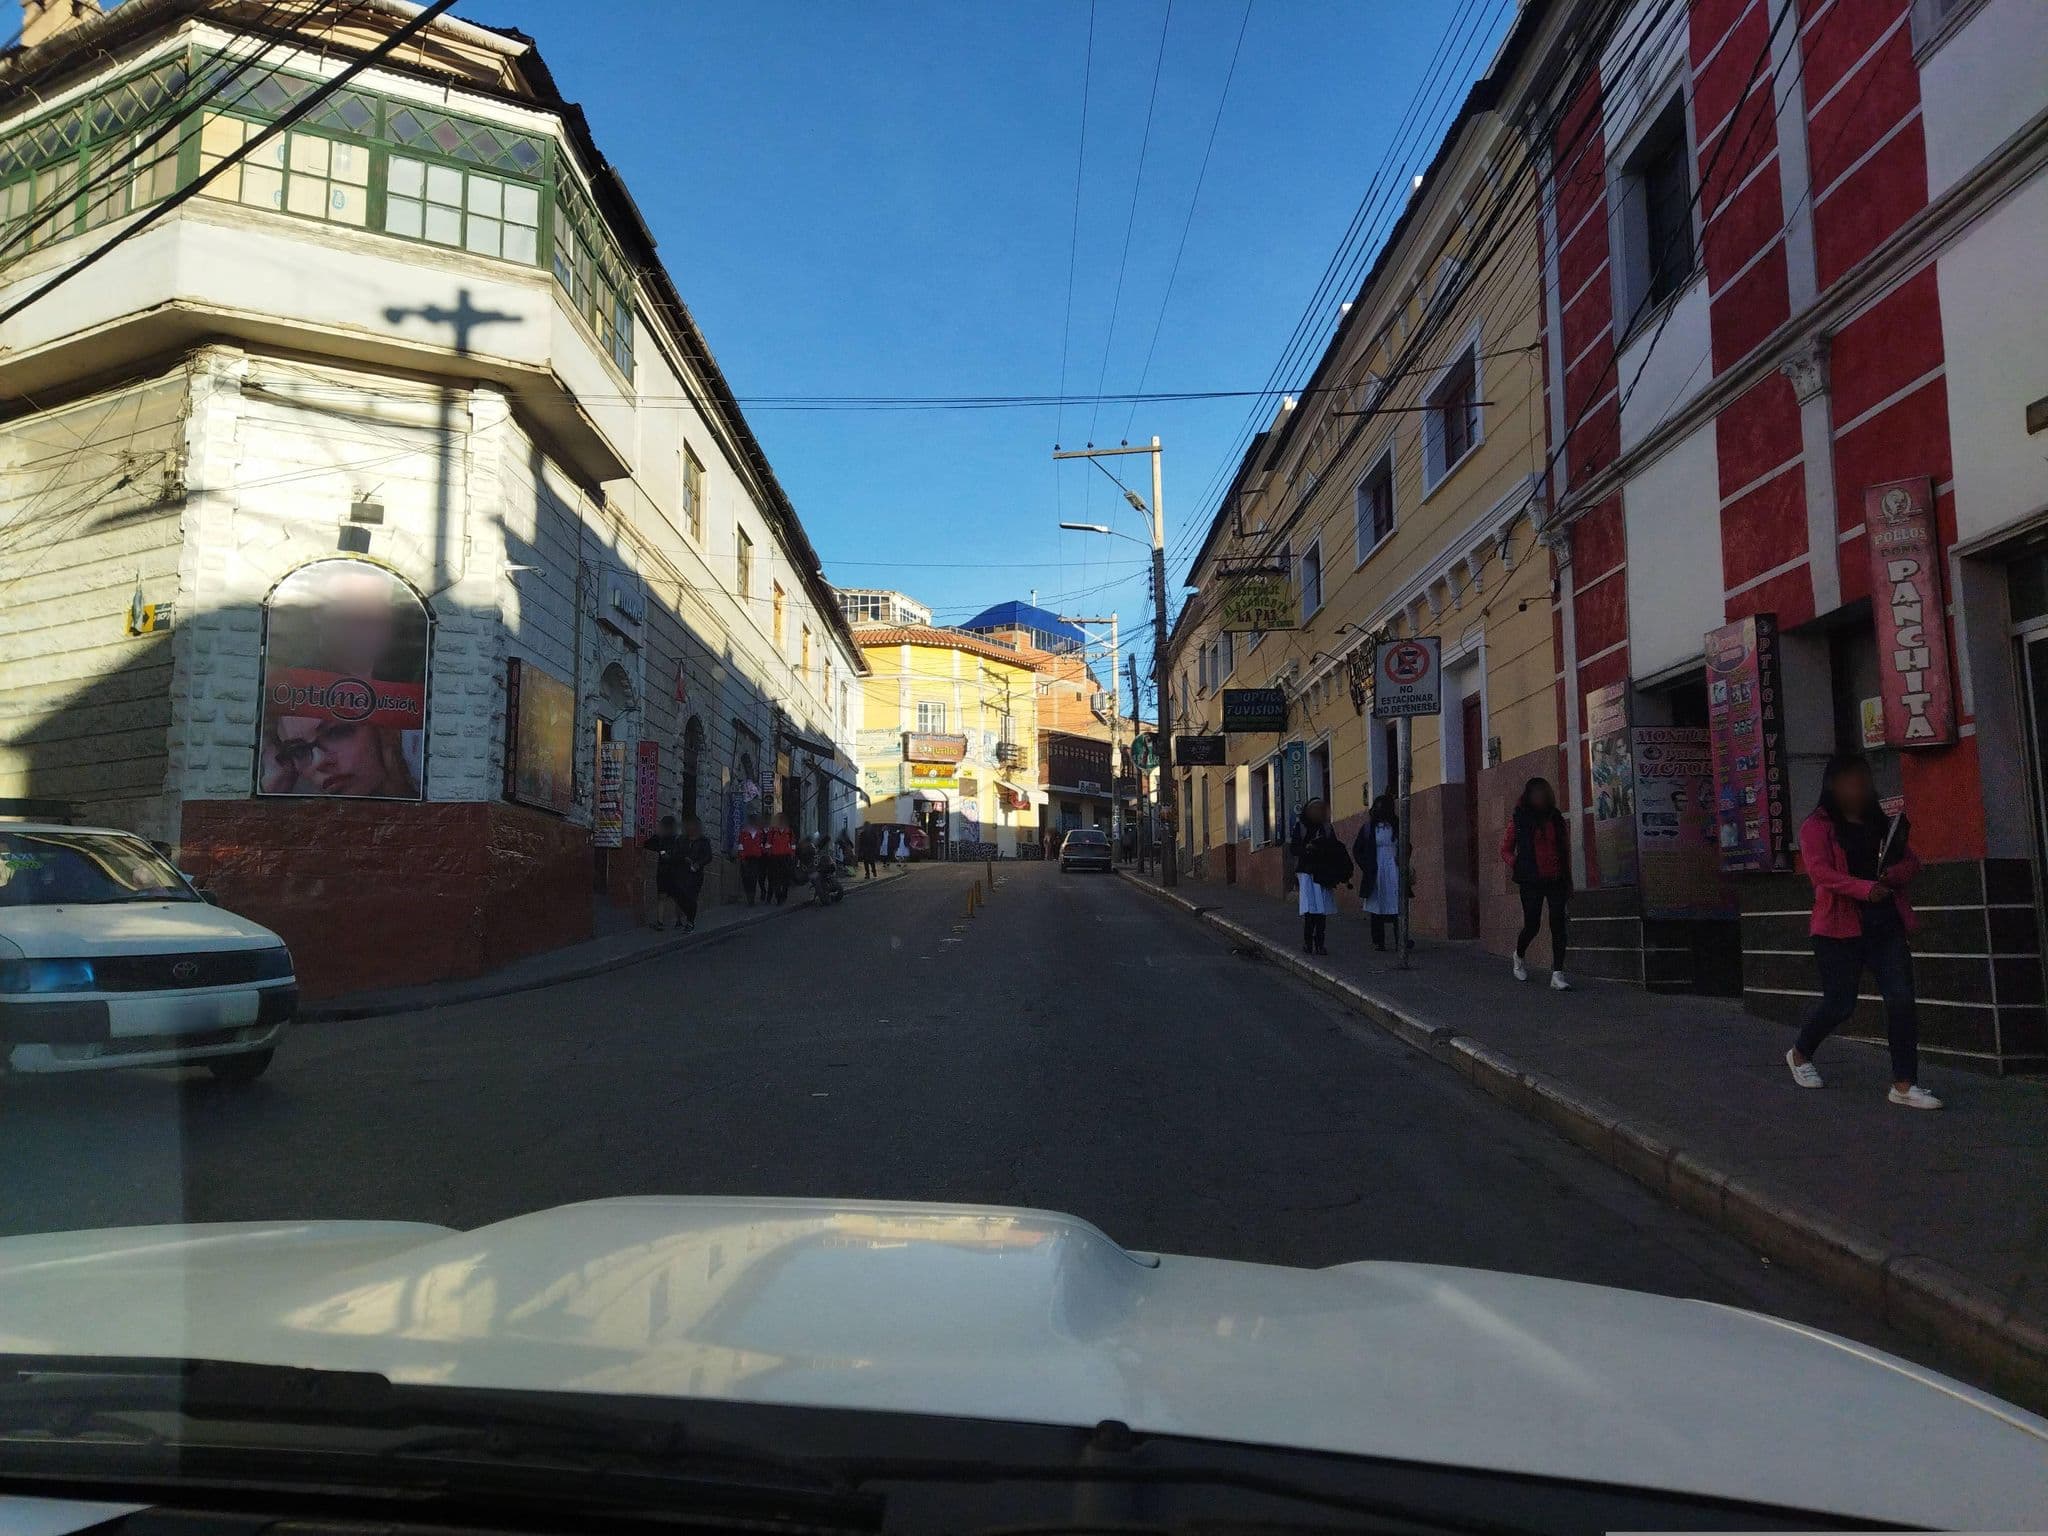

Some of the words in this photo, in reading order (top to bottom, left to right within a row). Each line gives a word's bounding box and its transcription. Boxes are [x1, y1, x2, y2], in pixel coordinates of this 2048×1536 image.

[1873, 527, 1927, 545] POLLOS
[1255, 608, 1278, 621] PAZ
[1886, 558, 1937, 740] PANCHITA
[1399, 685, 1413, 694] NO
[1381, 694, 1433, 705] ESTACIONAR
[1226, 704, 1282, 715] TUVISION
[1377, 706, 1389, 714] NO
[1391, 703, 1438, 713] DETENERSE
[1292, 750, 1303, 816] OPTIC
[1765, 733, 1786, 870] VICTORIA
